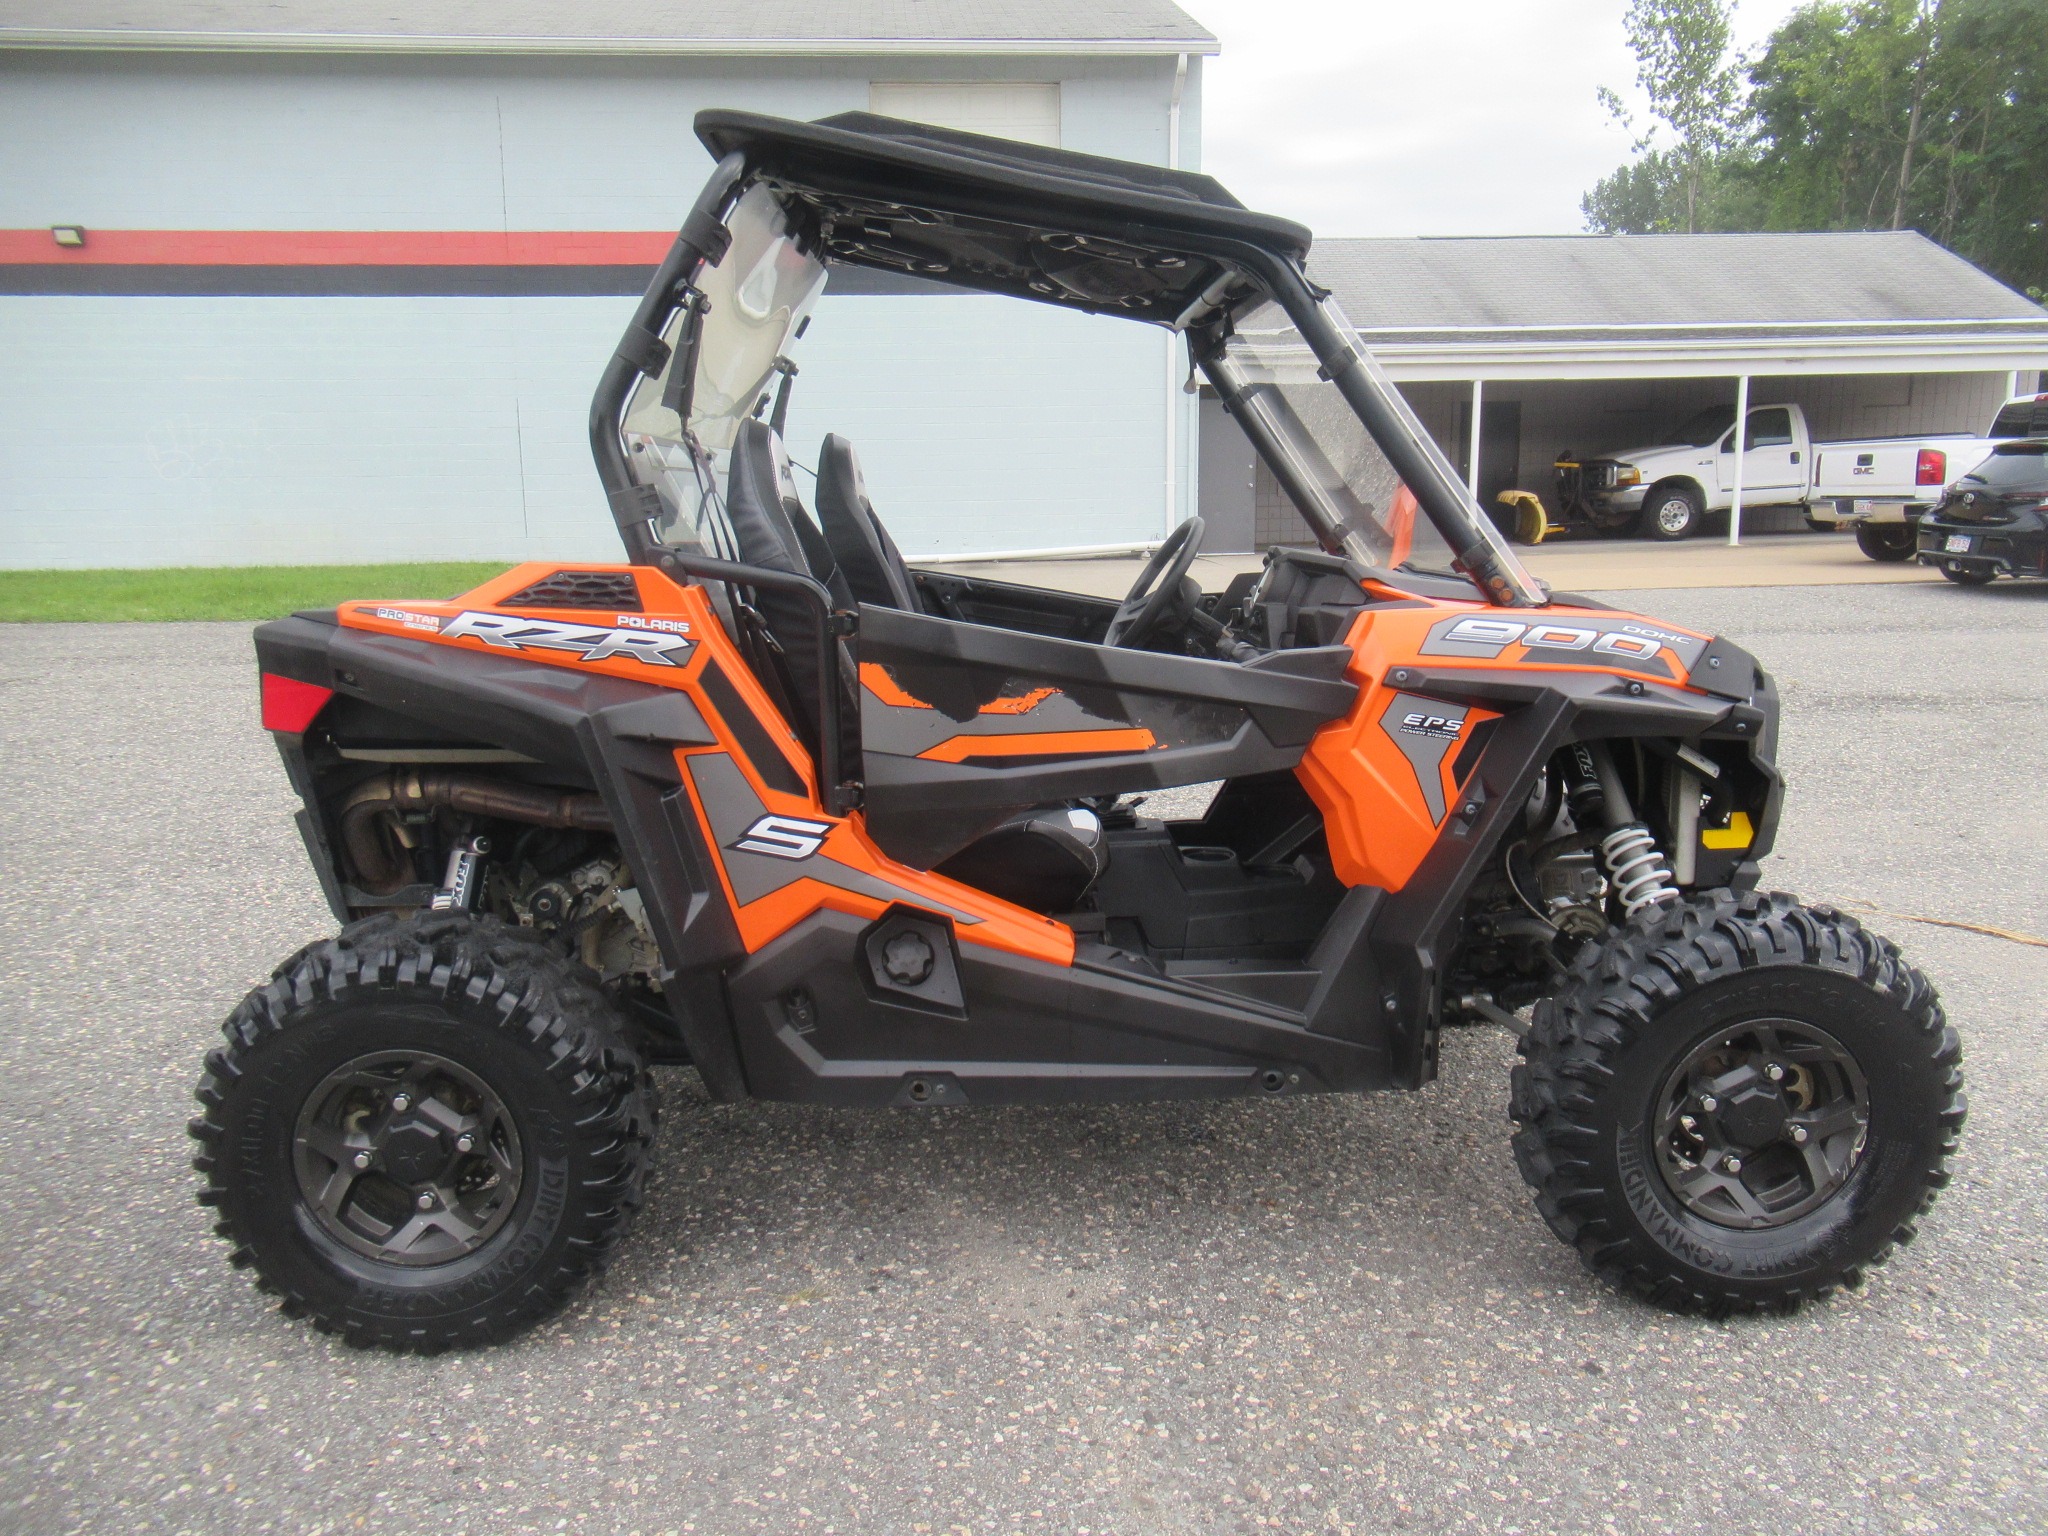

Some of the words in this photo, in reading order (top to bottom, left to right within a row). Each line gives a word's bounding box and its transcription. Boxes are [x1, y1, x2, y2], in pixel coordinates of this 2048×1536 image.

[1853, 467, 1875, 475] GMC
[378, 608, 440, 627] PROSTAR
[617, 615, 690, 633] POLARIS
[439, 610, 690, 667] RZR
[1444, 618, 1662, 661] 900
[1621, 624, 1693, 645] DOHC
[1403, 713, 1465, 731] EPS
[734, 814, 831, 860] S
